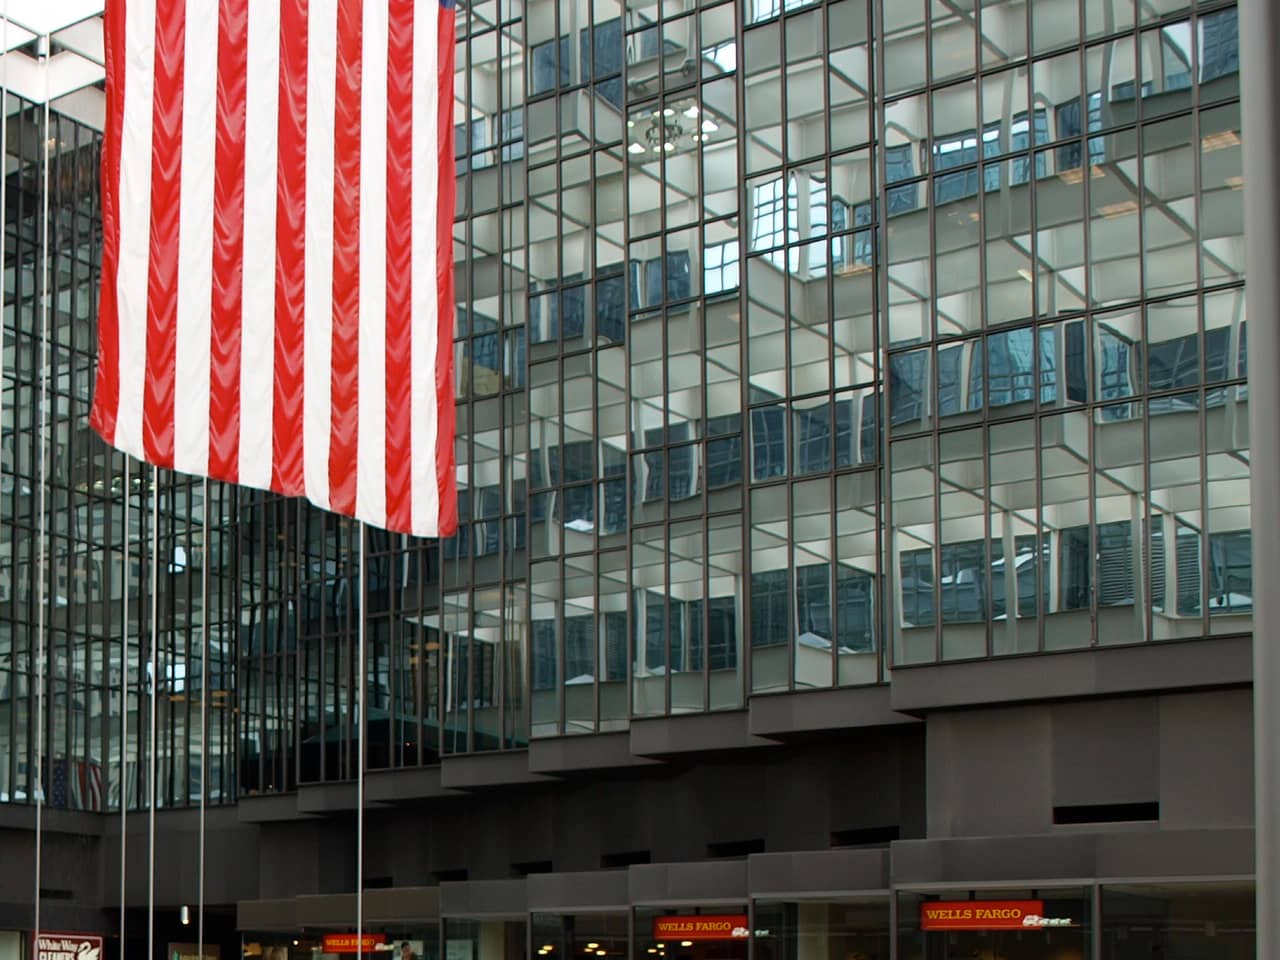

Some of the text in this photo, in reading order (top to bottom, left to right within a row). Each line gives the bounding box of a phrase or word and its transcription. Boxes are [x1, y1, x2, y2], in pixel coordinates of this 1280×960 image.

[926, 908, 1022, 919] WELLS FARGO
[658, 922, 732, 932] WELLS FARGO
